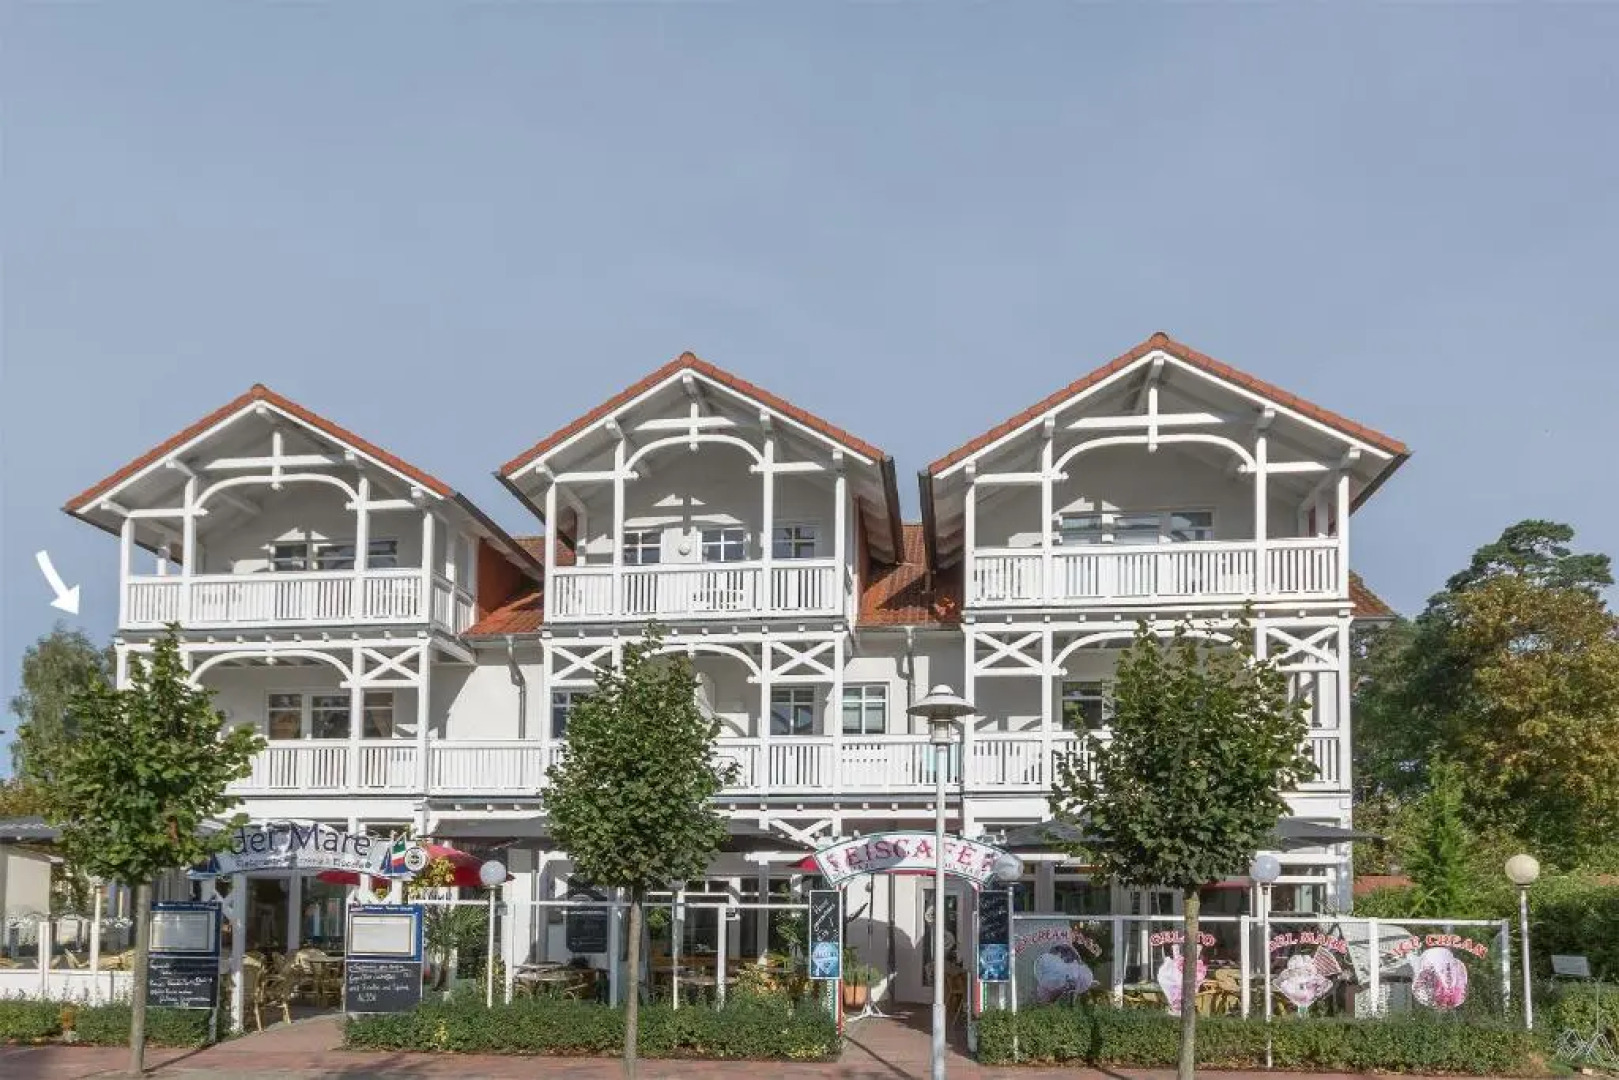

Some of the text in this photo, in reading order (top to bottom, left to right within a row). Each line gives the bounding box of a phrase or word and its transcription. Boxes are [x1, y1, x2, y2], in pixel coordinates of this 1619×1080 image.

[288, 822, 371, 856] Mare
[1150, 930, 1215, 946] GELTO
[1425, 934, 1488, 959] CREAM
